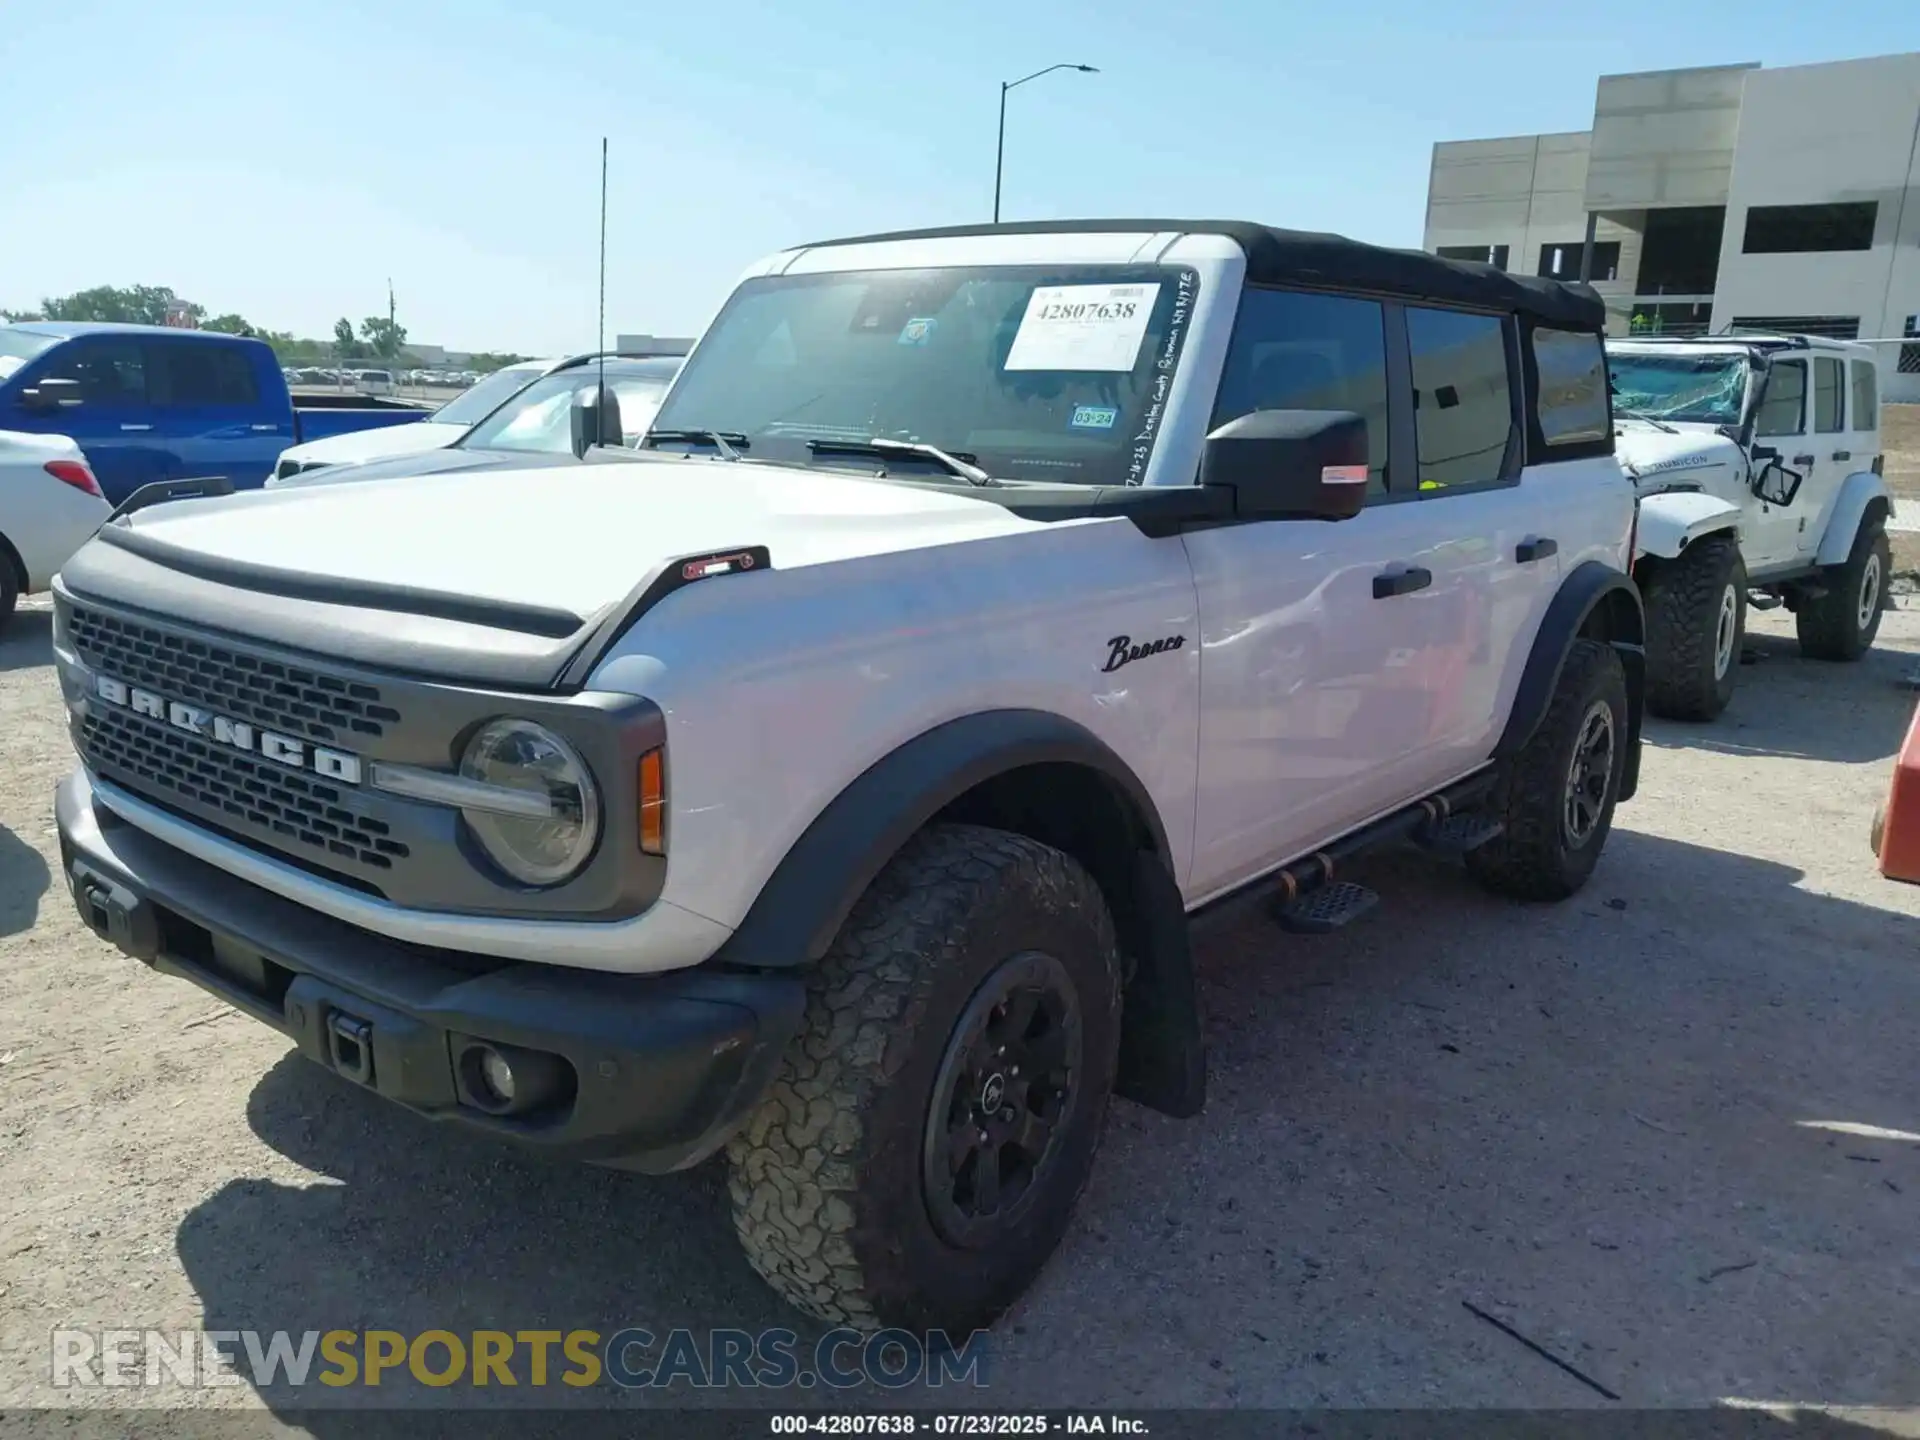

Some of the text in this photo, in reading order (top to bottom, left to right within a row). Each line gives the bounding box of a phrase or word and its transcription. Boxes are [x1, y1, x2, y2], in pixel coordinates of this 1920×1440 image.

[1036, 302, 1137, 320] 42807638
[1101, 635, 1187, 672] Bronco
[98, 674, 362, 784] BRONCO
